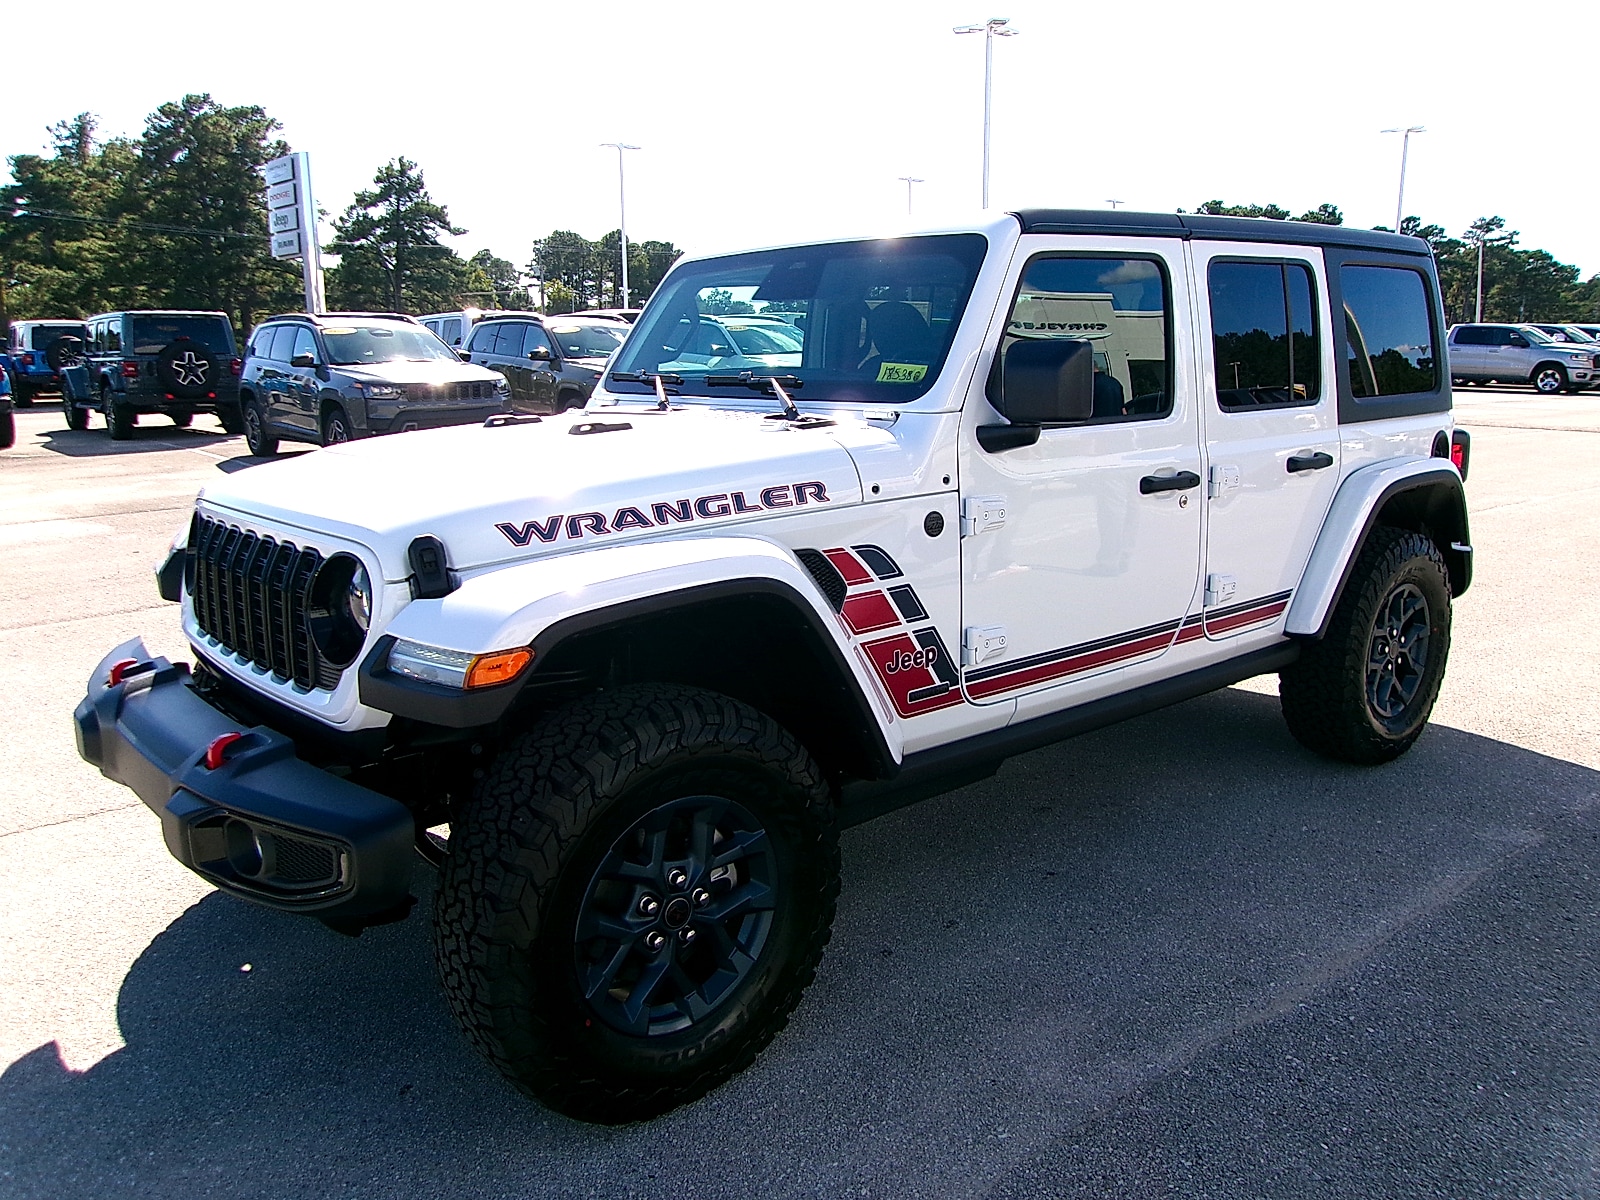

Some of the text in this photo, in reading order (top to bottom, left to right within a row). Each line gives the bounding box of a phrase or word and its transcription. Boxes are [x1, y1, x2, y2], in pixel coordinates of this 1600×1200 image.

[270, 191, 290, 202] DODGE
[274, 213, 289, 228] Jeep
[494, 481, 830, 547] WRANGLER
[885, 646, 938, 675] Jeep
